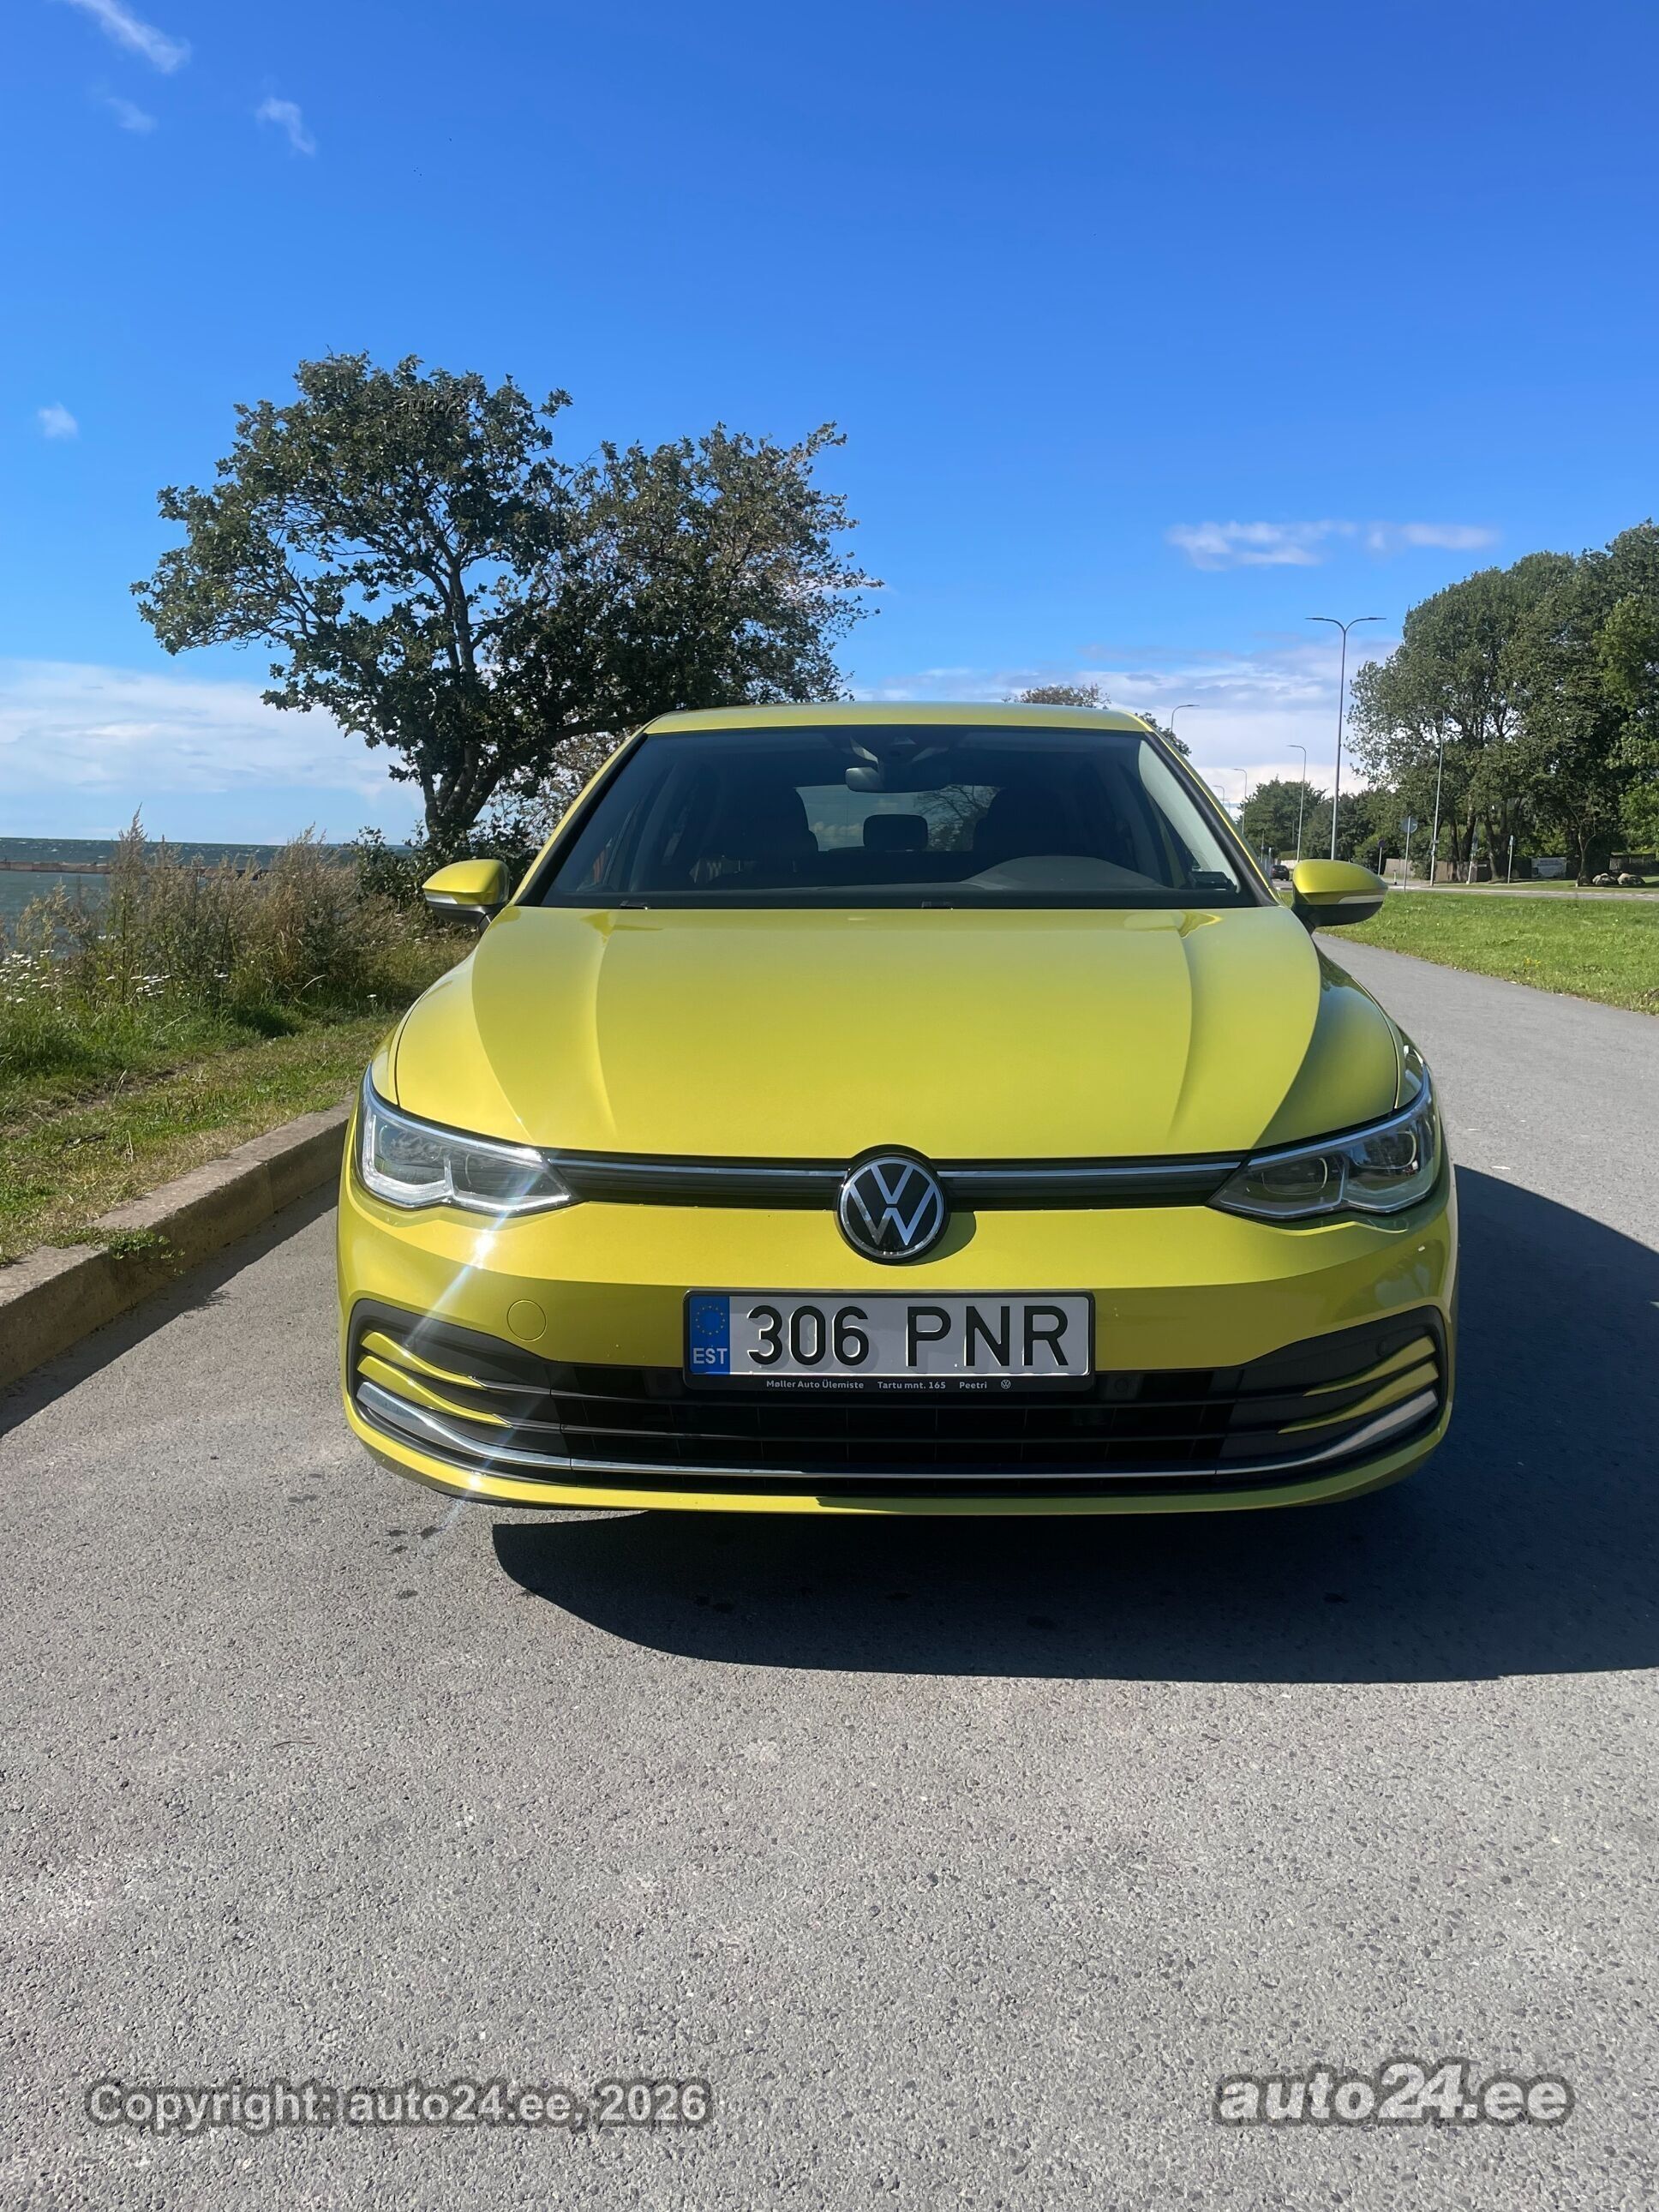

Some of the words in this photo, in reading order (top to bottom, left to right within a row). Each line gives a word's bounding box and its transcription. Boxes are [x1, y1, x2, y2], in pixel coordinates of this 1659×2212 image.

[746, 1304, 869, 1368] 306
[906, 1304, 1069, 1368] PNR
[692, 1347, 728, 1365] EST
[766, 1379, 796, 1388] Møller
[797, 1380, 820, 1388] Auto
[822, 1377, 865, 1389] Ülemiste
[877, 1381, 902, 1389] Tartu
[904, 1381, 927, 1389] mnt.
[928, 1381, 946, 1389] 165
[959, 1381, 987, 1389] Peetri
